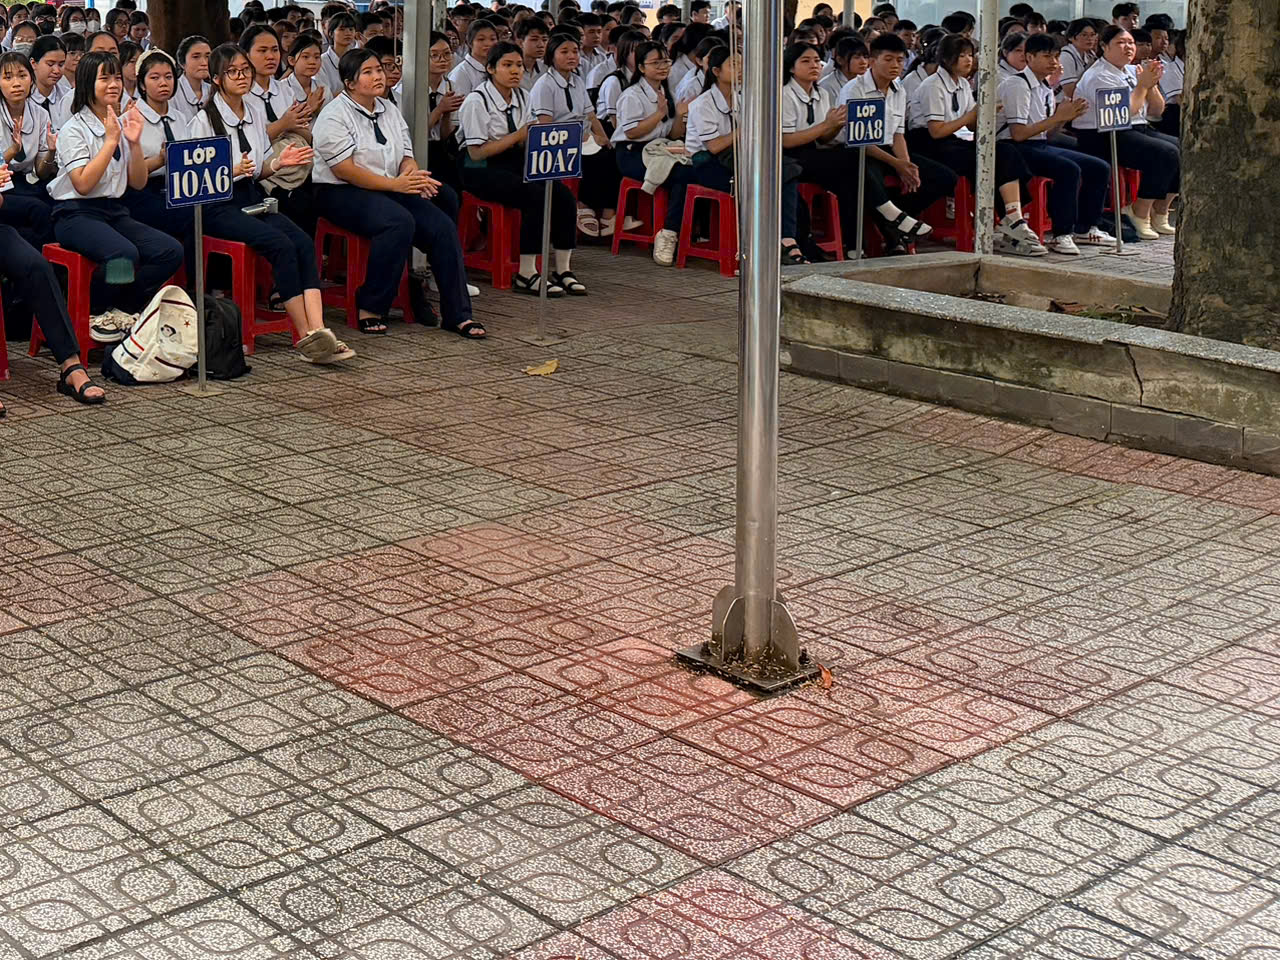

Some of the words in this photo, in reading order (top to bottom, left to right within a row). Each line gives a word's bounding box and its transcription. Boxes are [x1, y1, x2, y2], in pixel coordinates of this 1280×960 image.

[1100, 105, 1129, 127] 10A9
[540, 127, 569, 146] LỚP
[848, 119, 883, 142] 10A8
[183, 144, 216, 166] LỚP
[529, 147, 578, 175] 10A7
[170, 165, 230, 200] 10A6
